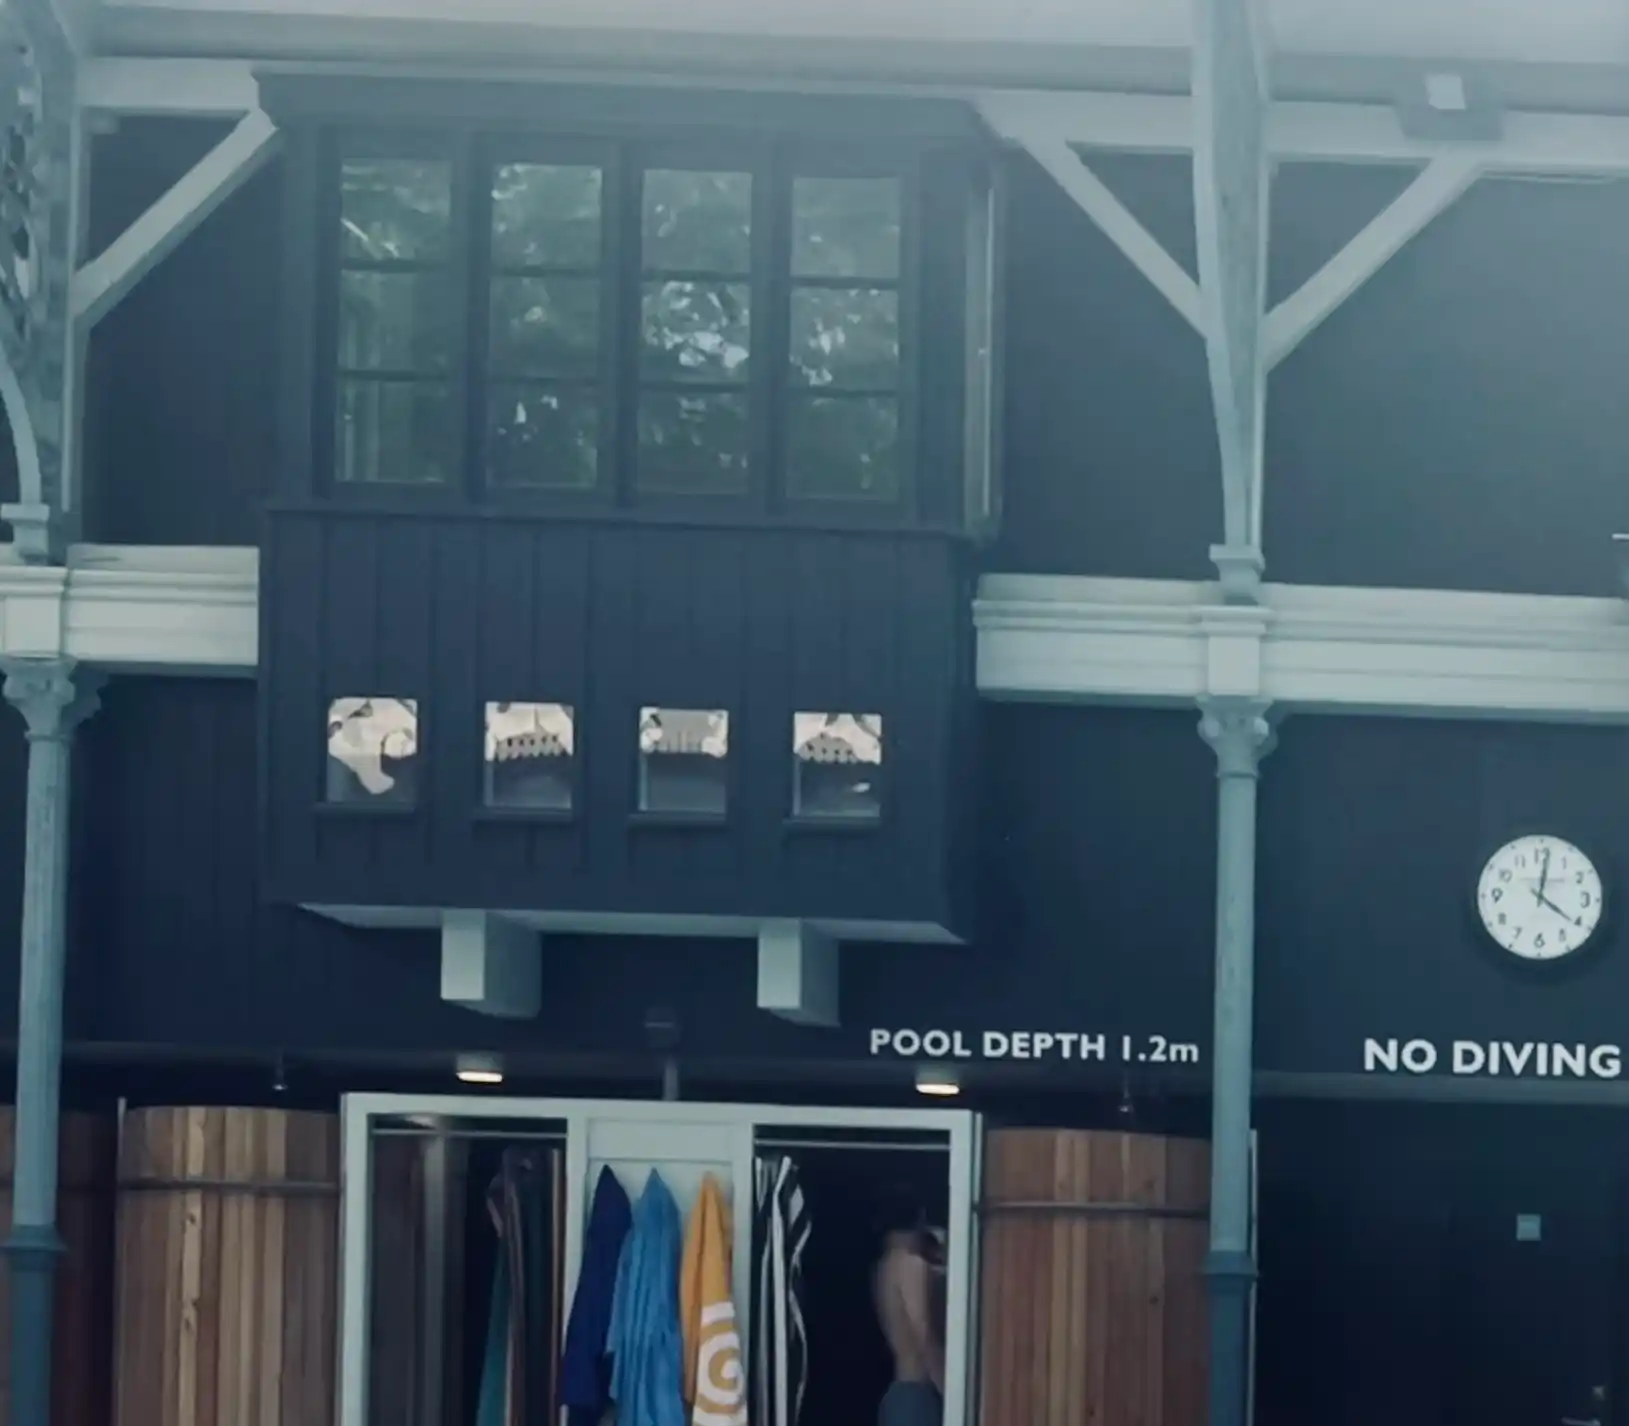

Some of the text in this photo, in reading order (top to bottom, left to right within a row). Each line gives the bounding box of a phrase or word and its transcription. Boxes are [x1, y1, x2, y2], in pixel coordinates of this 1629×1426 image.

[1491, 887, 1504, 904] 9
[1533, 931, 1546, 949] 6
[869, 1028, 1199, 1063] POOL DEPTH 1.2m
[1363, 1038, 1622, 1078] NO DIVING
